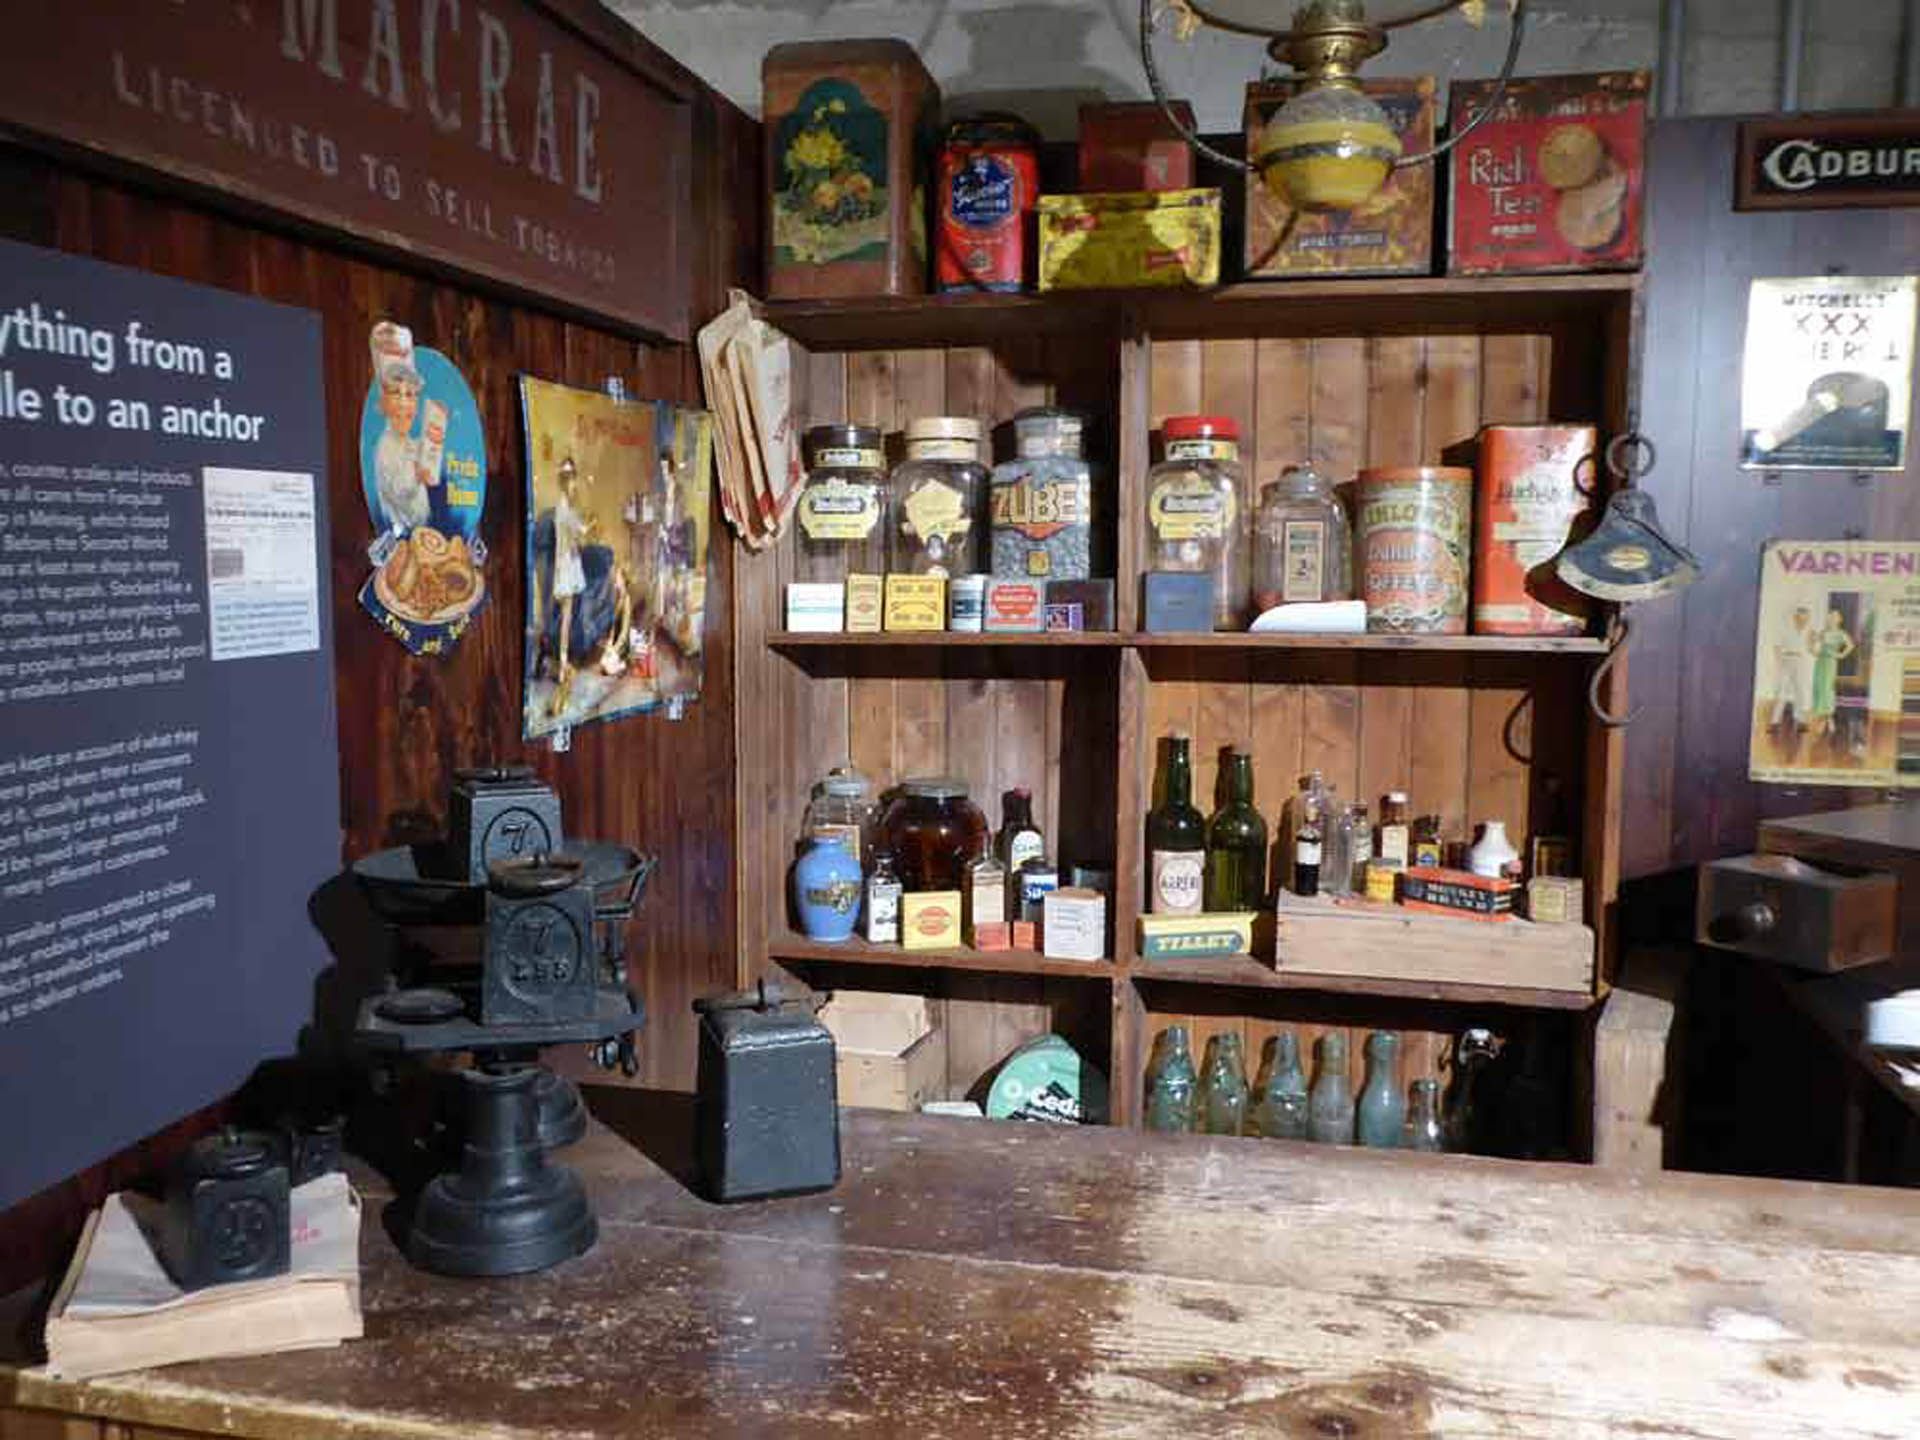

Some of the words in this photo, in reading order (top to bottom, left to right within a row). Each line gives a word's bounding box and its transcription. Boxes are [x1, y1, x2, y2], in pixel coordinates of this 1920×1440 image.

[281, 0, 604, 203] MACRAE
[361, 153, 402, 200] TO
[426, 178, 498, 242] SELL
[125, 321, 206, 375] from
[214, 351, 233, 379] a
[0, 369, 42, 420] le
[53, 384, 96, 425] to
[107, 398, 150, 431] an
[161, 399, 265, 441] anchor
[1777, 549, 1920, 576] VARNEN
[501, 822, 530, 855] 7
